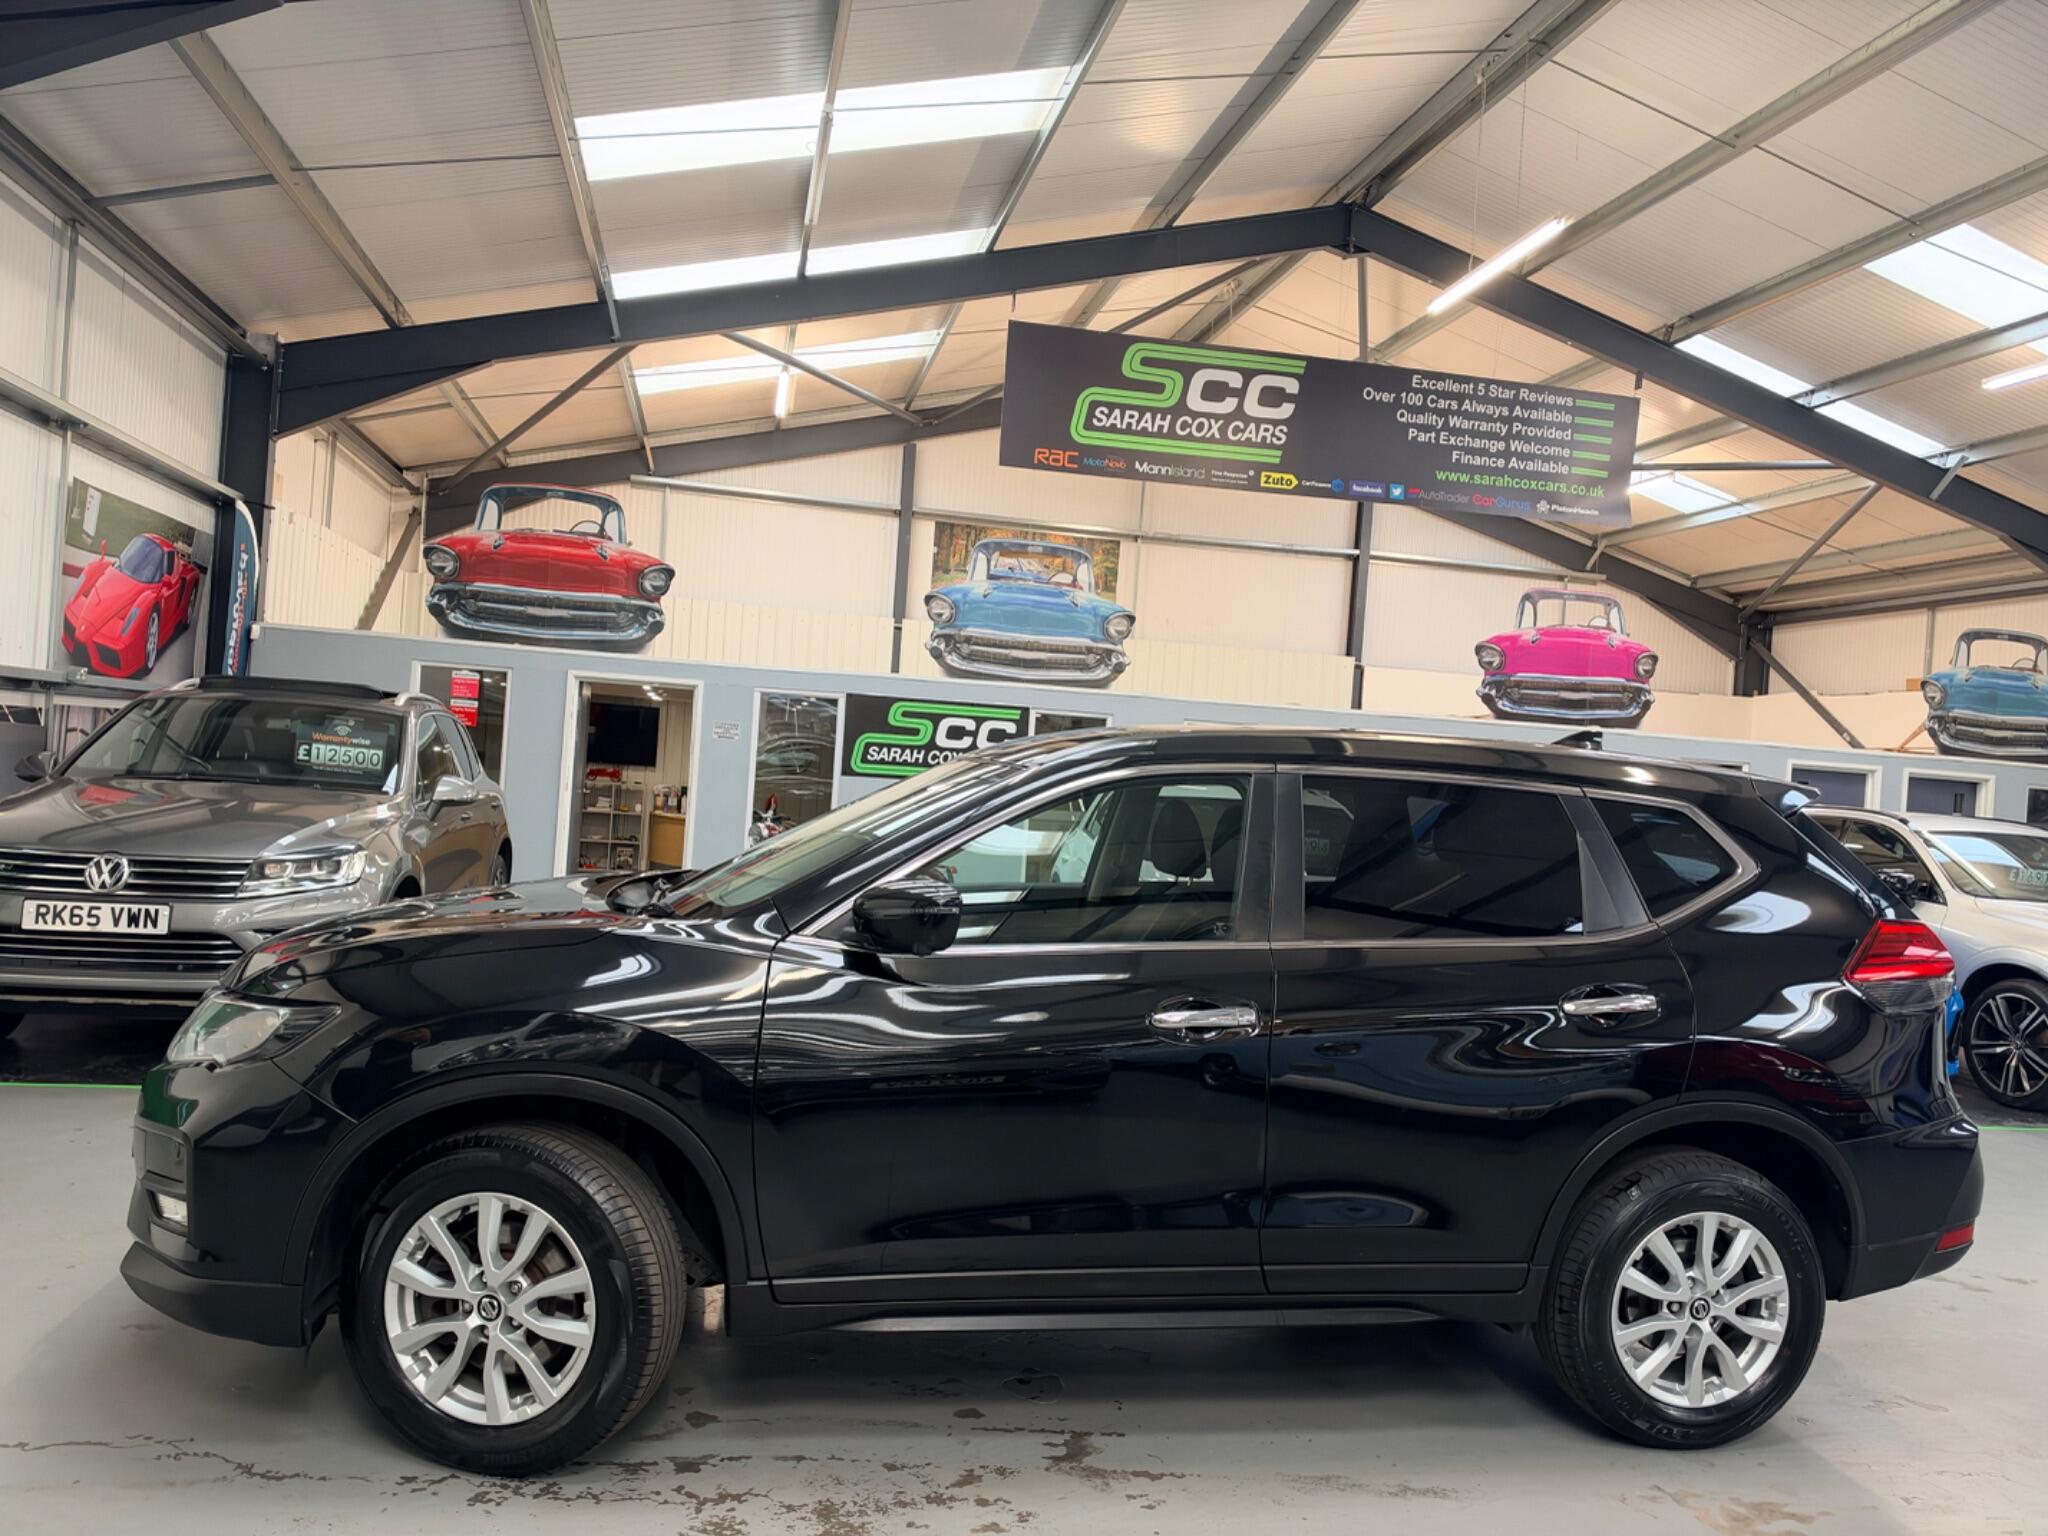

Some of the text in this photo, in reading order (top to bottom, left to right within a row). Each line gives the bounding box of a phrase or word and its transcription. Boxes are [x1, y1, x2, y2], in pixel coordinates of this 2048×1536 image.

[1411, 374, 1574, 407] Excellent 5 Star Reviews
[1362, 387, 1573, 424] Over 100 Cars Always Available
[1092, 406, 1289, 445] SARAH COX CARS
[1396, 409, 1572, 441] Quality Warranty Provided
[1408, 428, 1571, 458] Part Exchange Welcome
[1451, 450, 1569, 475] Finance Available
[1263, 474, 1293, 487] Zuto
[1436, 470, 1605, 498] www.sarahcoxcars.co.uk
[1472, 494, 1532, 512] CarGurus
[312, 731, 371, 746] Warrantywise
[297, 743, 381, 768] £12500
[866, 746, 924, 764] SARAH
[34, 904, 160, 929] RK65 VWN
